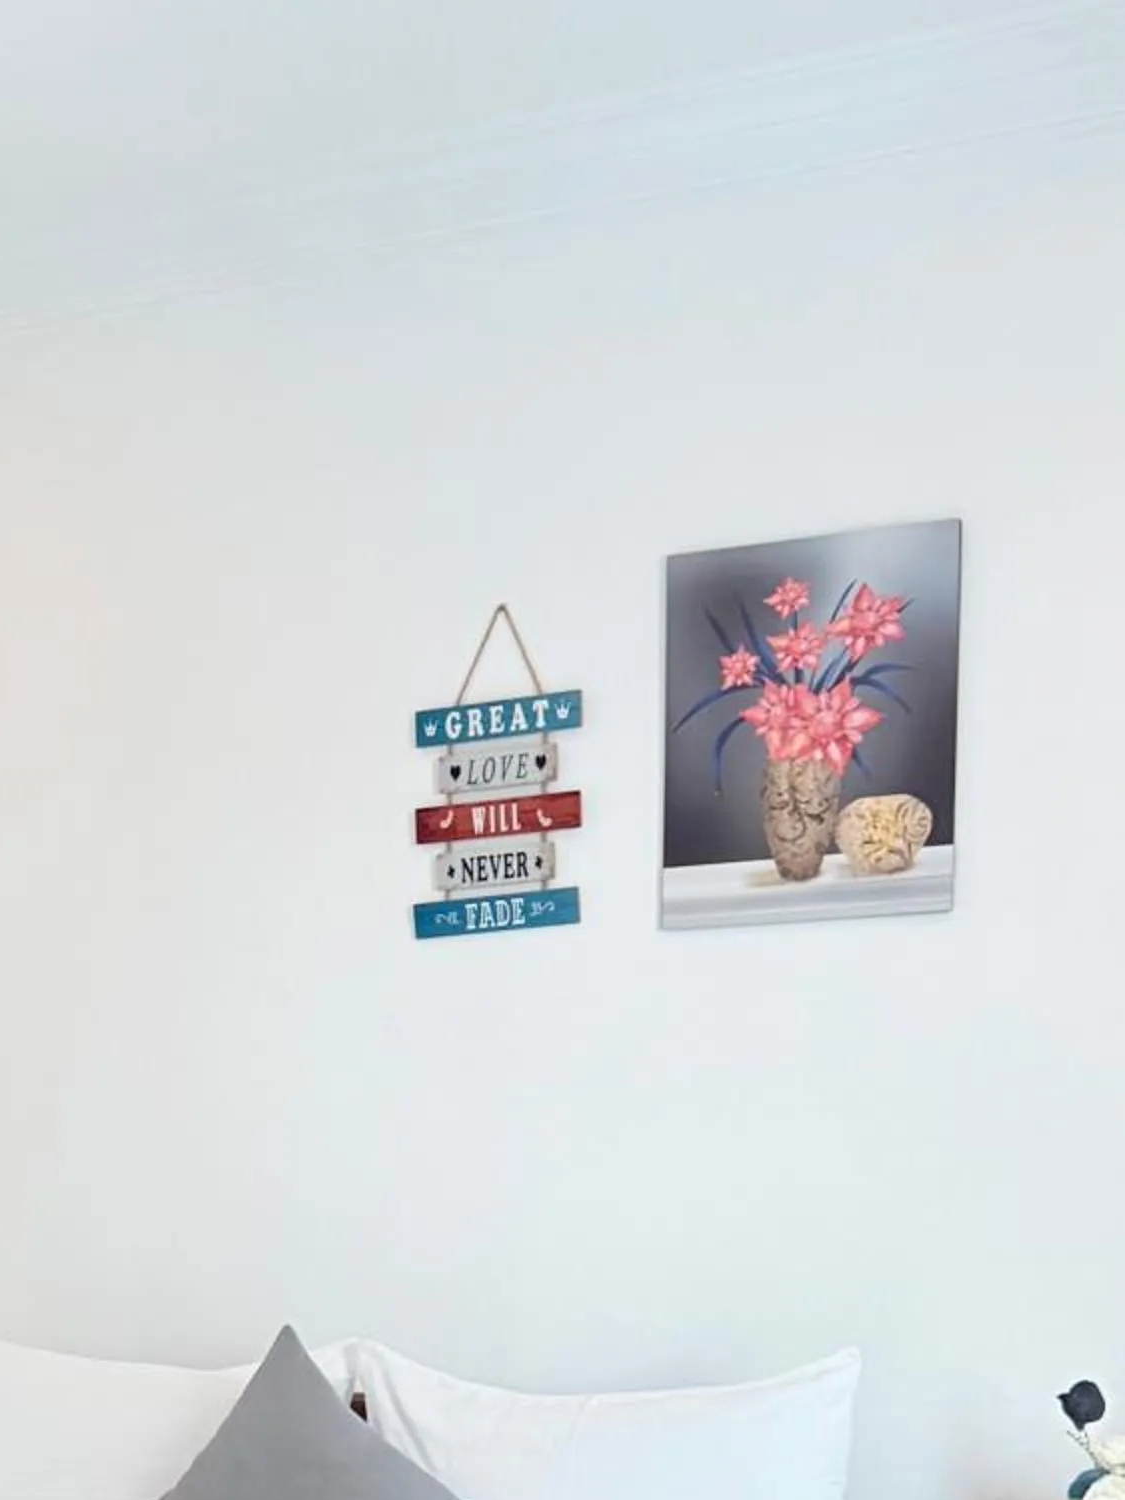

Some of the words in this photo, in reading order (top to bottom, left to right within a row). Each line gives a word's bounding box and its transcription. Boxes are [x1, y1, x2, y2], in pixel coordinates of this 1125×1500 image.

[445, 700, 549, 739] GREAT
[467, 753, 529, 785] LOVE
[471, 803, 522, 834] WILL
[461, 852, 529, 884] NEVER
[464, 898, 526, 930] FADE
